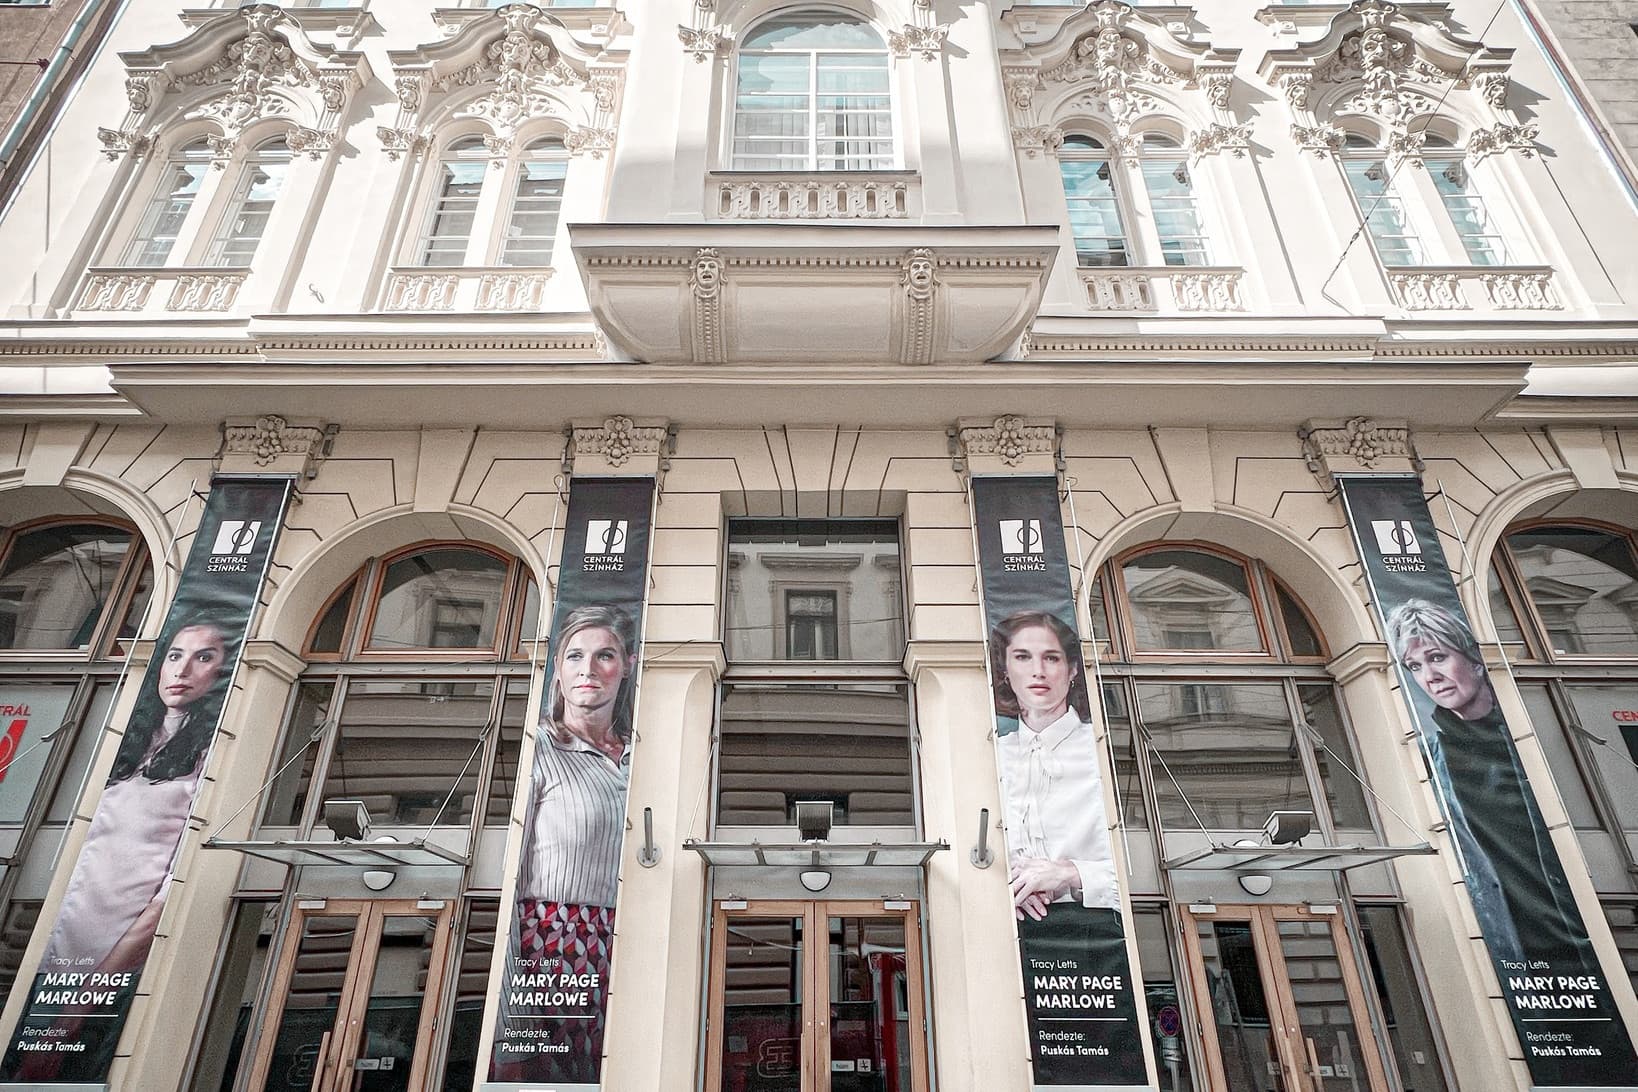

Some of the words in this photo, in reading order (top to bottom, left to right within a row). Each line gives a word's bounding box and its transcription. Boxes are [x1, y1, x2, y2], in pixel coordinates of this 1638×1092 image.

[209, 555, 248, 563] CENTRÁL
[583, 555, 624, 563] CENTRÁL
[1003, 554, 1045, 563] CENTRÁL
[1382, 555, 1424, 563] CENTRÁL
[206, 563, 247, 572] SZÍNHÁZ
[583, 563, 624, 571] SZÍNHÁZ
[1004, 563, 1046, 571] SZÍNHÁZ
[1385, 563, 1427, 572] SZÍNHÁZ
[50, 955, 73, 967] Tracy
[74, 956, 95, 966] Letts
[514, 957, 537, 968] Tracy
[539, 957, 560, 967] Letts
[1030, 959, 1055, 971] Tracy
[1057, 959, 1078, 969] Letts
[1500, 959, 1526, 971] Tracy
[1528, 960, 1550, 970] Letts
[42, 972, 89, 986] MARY
[90, 973, 132, 987] PAGE
[511, 974, 557, 987] MARY
[559, 974, 600, 987] PAGE
[1034, 976, 1078, 990] MARY
[1081, 976, 1123, 990] PAGE
[1509, 976, 1554, 990] MARY
[1556, 976, 1600, 990] PAGE
[35, 991, 117, 1005] MARLOWE
[509, 992, 589, 1006] MARLOWE
[1036, 994, 1116, 1009] MARLOWE
[1515, 994, 1597, 1009] MARLOWE
[22, 1026, 69, 1037] Rendezte:
[504, 1027, 551, 1038] Rendezte:
[1039, 1030, 1086, 1041] Rendezte:
[1526, 1031, 1574, 1042] Rendezte:
[17, 1040, 53, 1051] Puskás
[55, 1041, 86, 1052] Tamás
[501, 1041, 536, 1053] Puskás
[537, 1041, 570, 1053] Tamás
[1040, 1044, 1075, 1056] Puskás
[1076, 1045, 1109, 1056] Tamás
[1531, 1046, 1566, 1057] Puskás
[1566, 1045, 1602, 1056] Tamás
